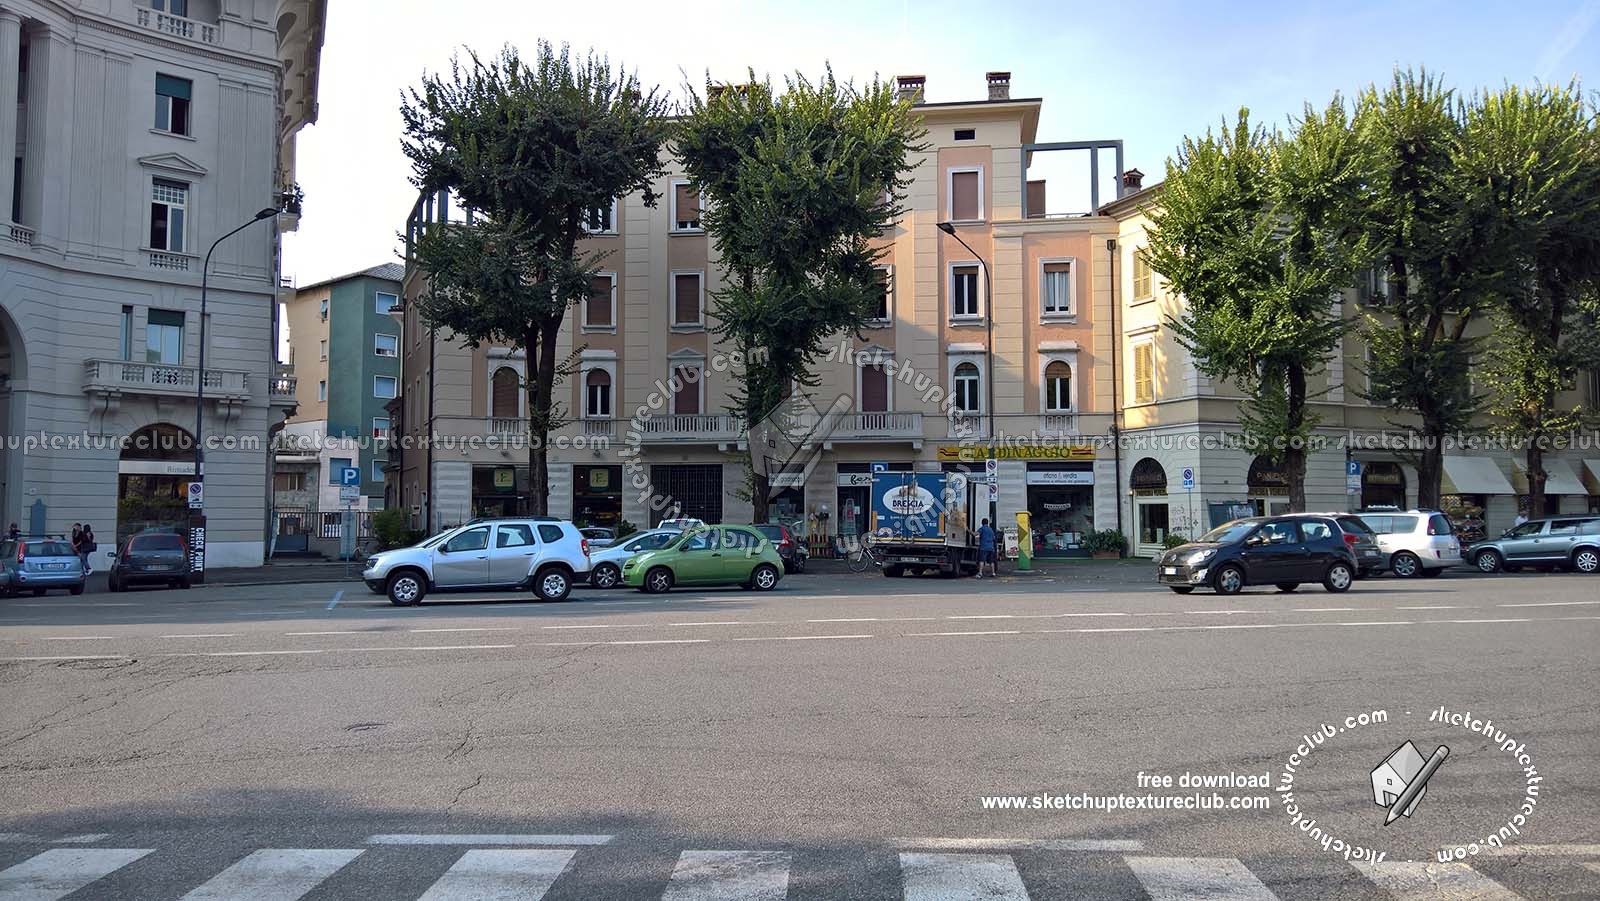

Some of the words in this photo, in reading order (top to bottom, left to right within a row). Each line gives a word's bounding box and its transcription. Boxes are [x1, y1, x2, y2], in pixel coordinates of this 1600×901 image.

[958, 447, 1071, 458] GIADINAGGIO
[1350, 463, 1357, 473] P
[344, 469, 357, 483] P
[195, 527, 205, 549] CHECK
[194, 552, 204, 572] POINT
